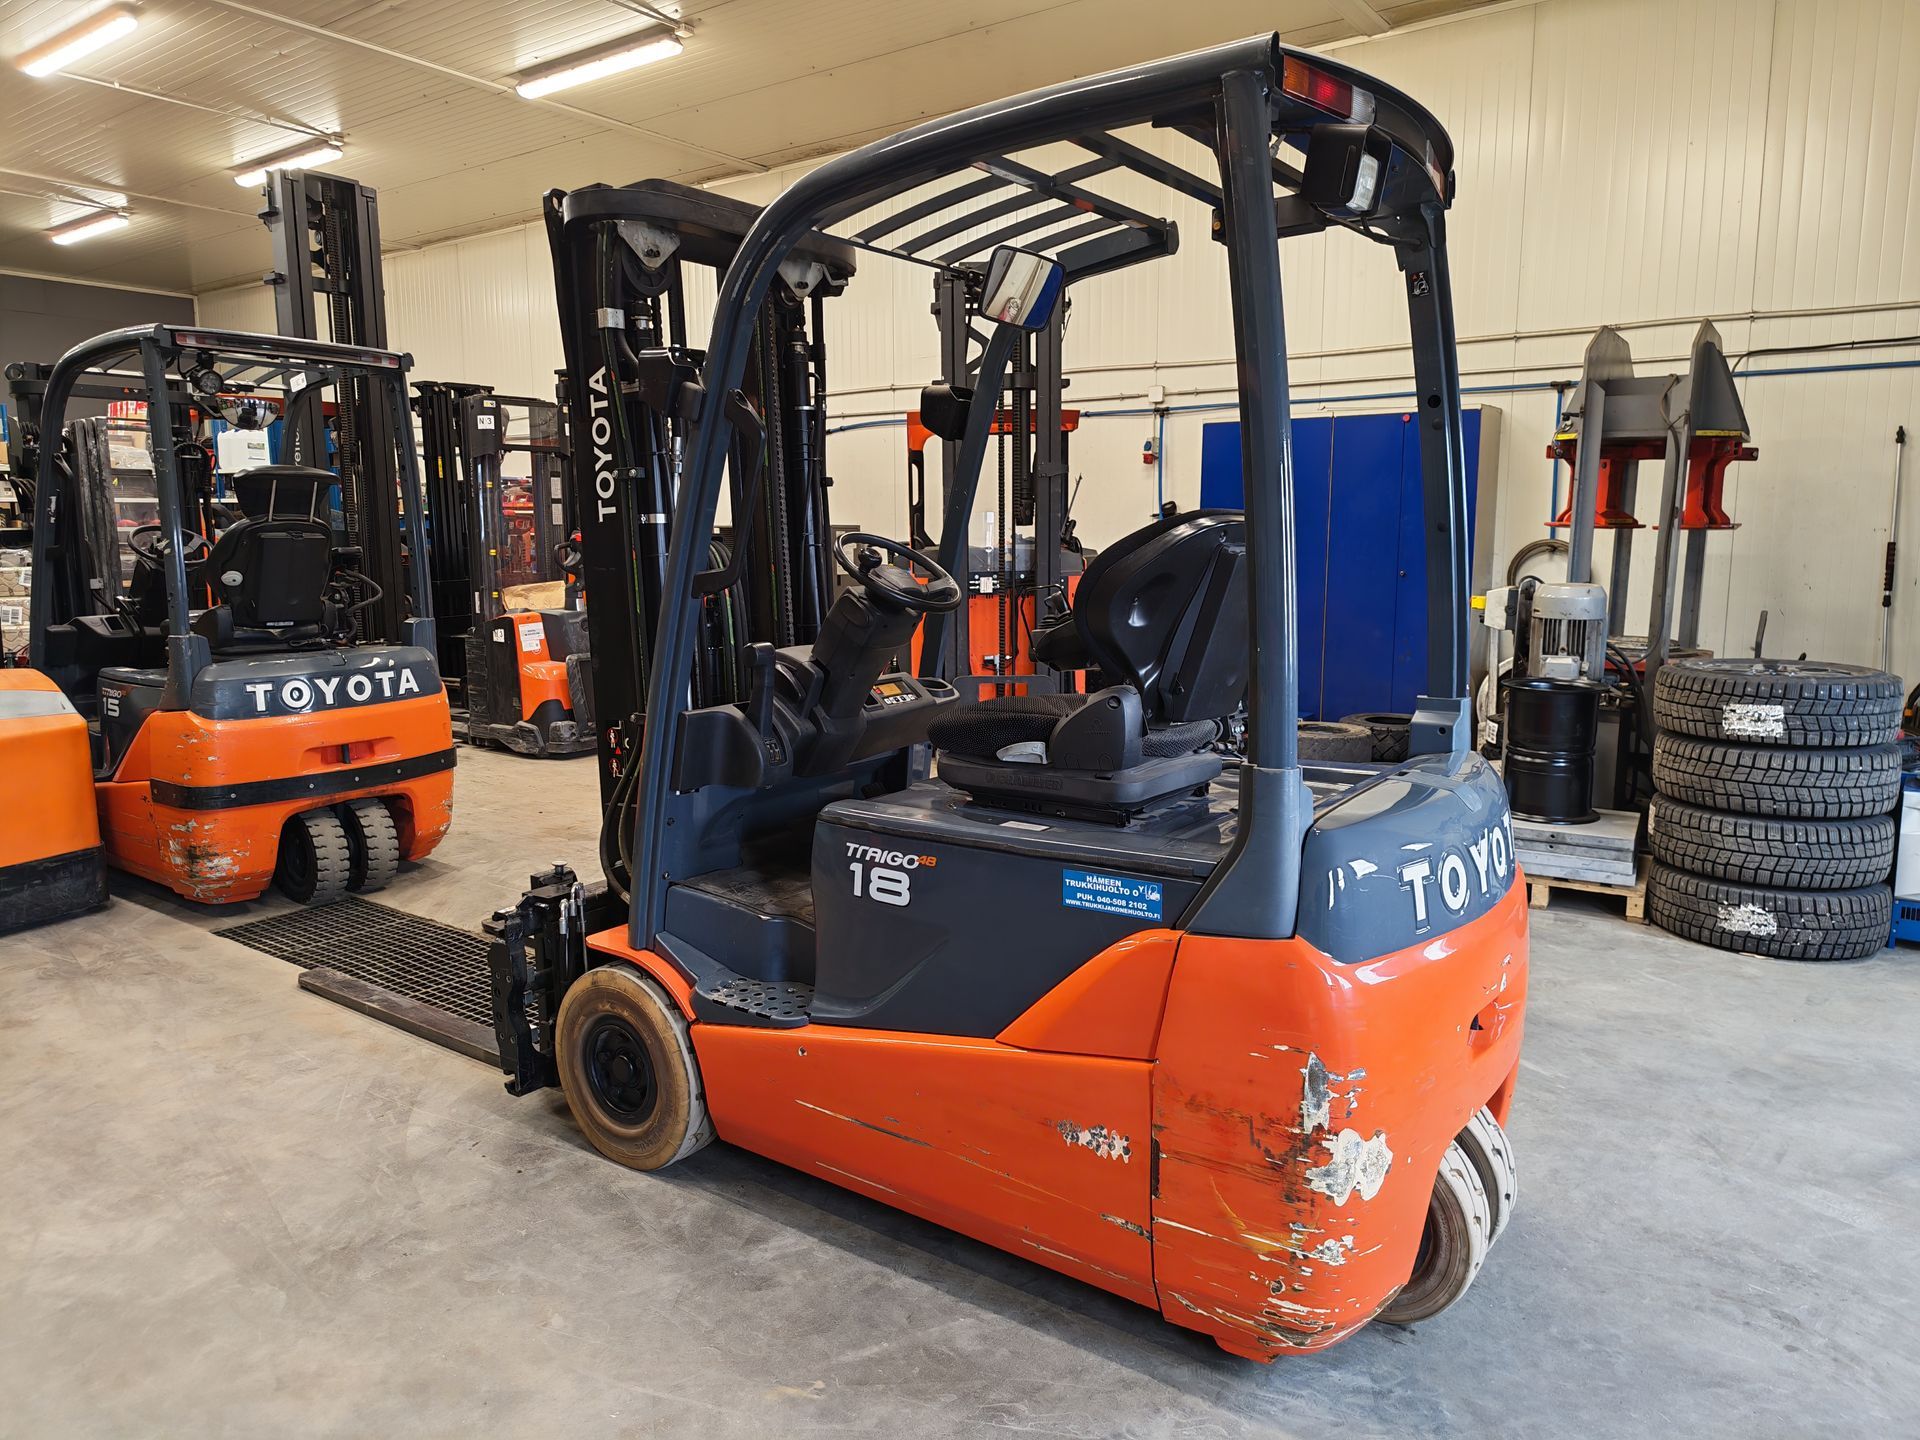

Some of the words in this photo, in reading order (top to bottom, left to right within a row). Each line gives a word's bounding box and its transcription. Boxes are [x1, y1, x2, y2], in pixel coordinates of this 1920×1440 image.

[588, 366, 617, 523] TOYOTA
[246, 669, 420, 712] TOYOTA
[102, 697, 120, 717] 15
[849, 862, 910, 907] 18
[1065, 879, 1130, 895] TRUKKIHUOLTO
[1077, 893, 1095, 901] PUH.
[1097, 896, 1126, 906] 040-508
[1129, 901, 1147, 910] 2102
